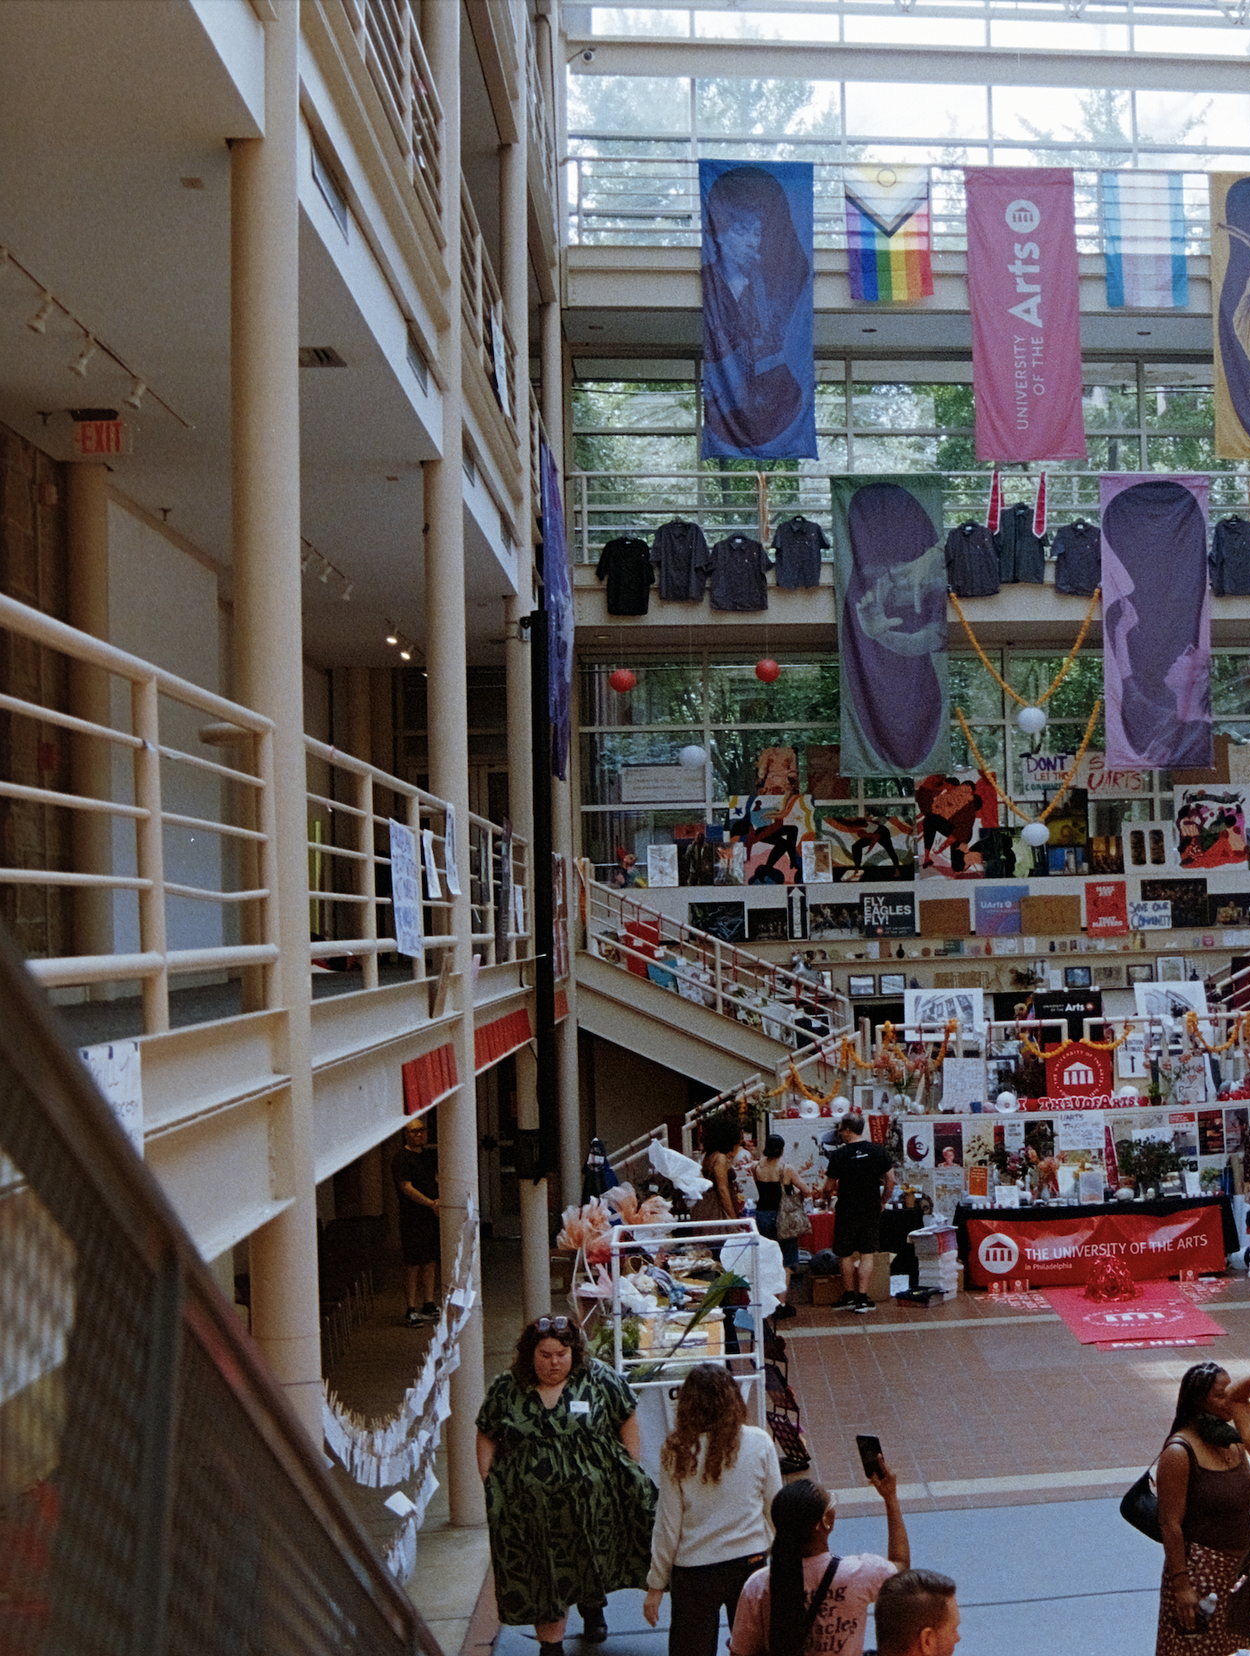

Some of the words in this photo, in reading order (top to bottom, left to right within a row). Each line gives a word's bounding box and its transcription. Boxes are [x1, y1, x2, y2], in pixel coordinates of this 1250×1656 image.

[1007, 241, 1043, 328] Arts
[1031, 336, 1044, 368] THE
[1014, 335, 1029, 430] UNIVERSITY
[1033, 376, 1045, 396] OF
[81, 421, 122, 454] EXIT
[1027, 755, 1068, 773] DONT
[864, 896, 885, 906] FLY
[980, 901, 1004, 909] UArts
[864, 905, 912, 916] EAGLES
[864, 915, 889, 925] FLY!
[1065, 1003, 1085, 1012] Arts
[1025, 1247, 1049, 1261] THE
[1053, 1242, 1127, 1259] UNIVERSITY
[1130, 1242, 1147, 1254] OF
[1150, 1239, 1174, 1253] THE
[1177, 1234, 1208, 1250] ARTS
[1033, 1262, 1073, 1271] Philadelphia
